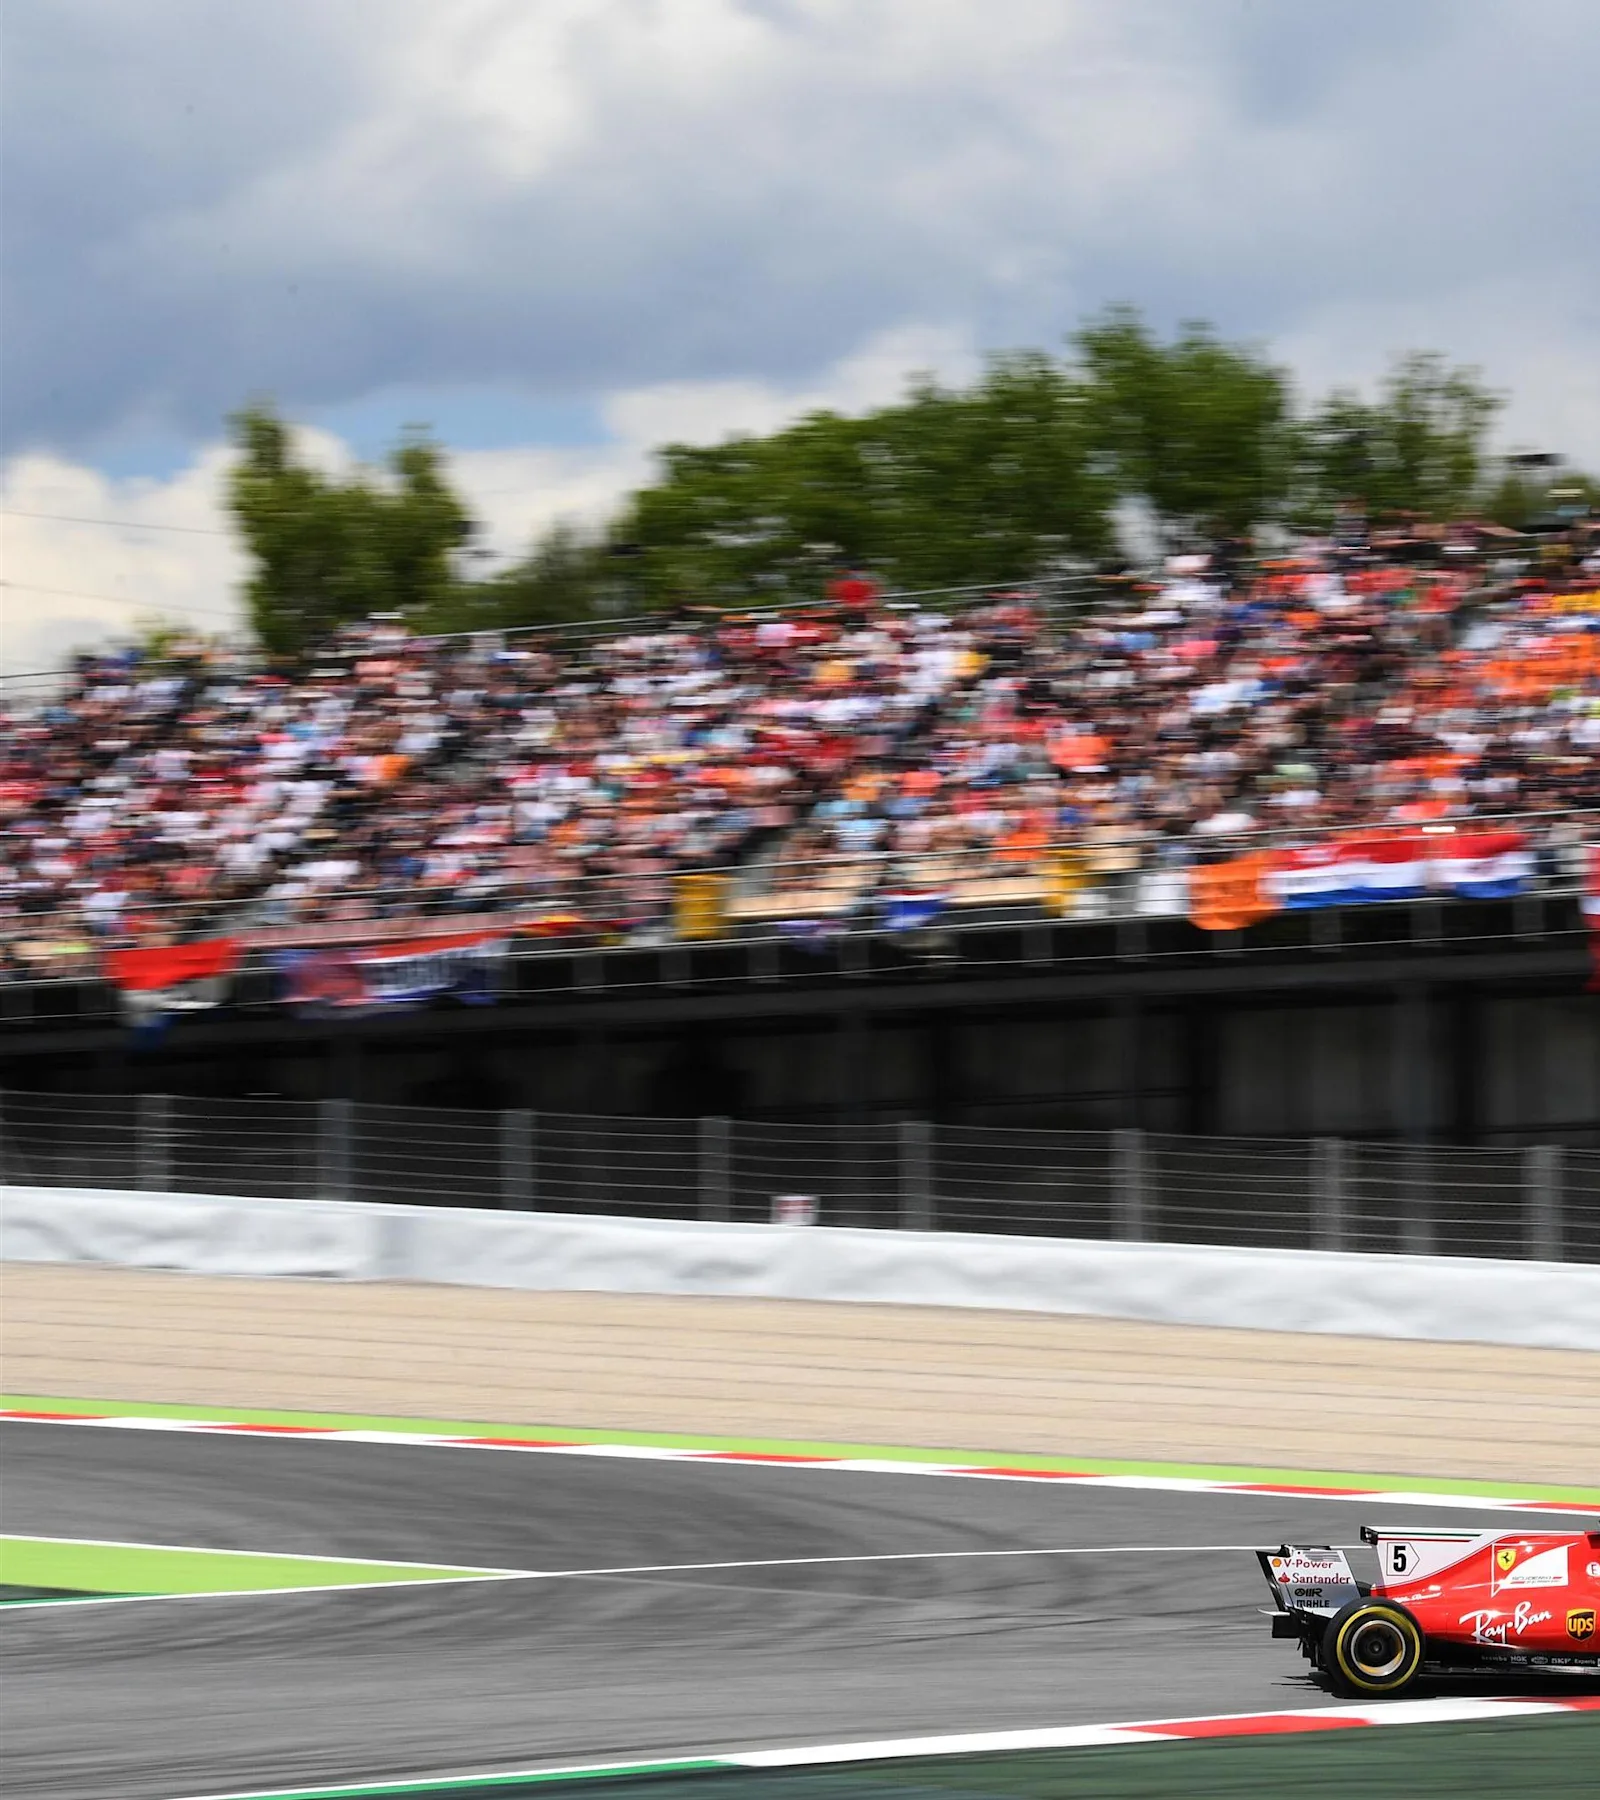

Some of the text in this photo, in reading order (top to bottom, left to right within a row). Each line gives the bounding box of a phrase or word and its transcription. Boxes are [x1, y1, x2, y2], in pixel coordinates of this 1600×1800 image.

[1284, 1559, 1334, 1569] V-Power
[1393, 1545, 1407, 1573] 5
[1292, 1573, 1351, 1584] Santander
[1296, 1600, 1330, 1608] MAHLE
[1568, 1618, 1594, 1637] ups
